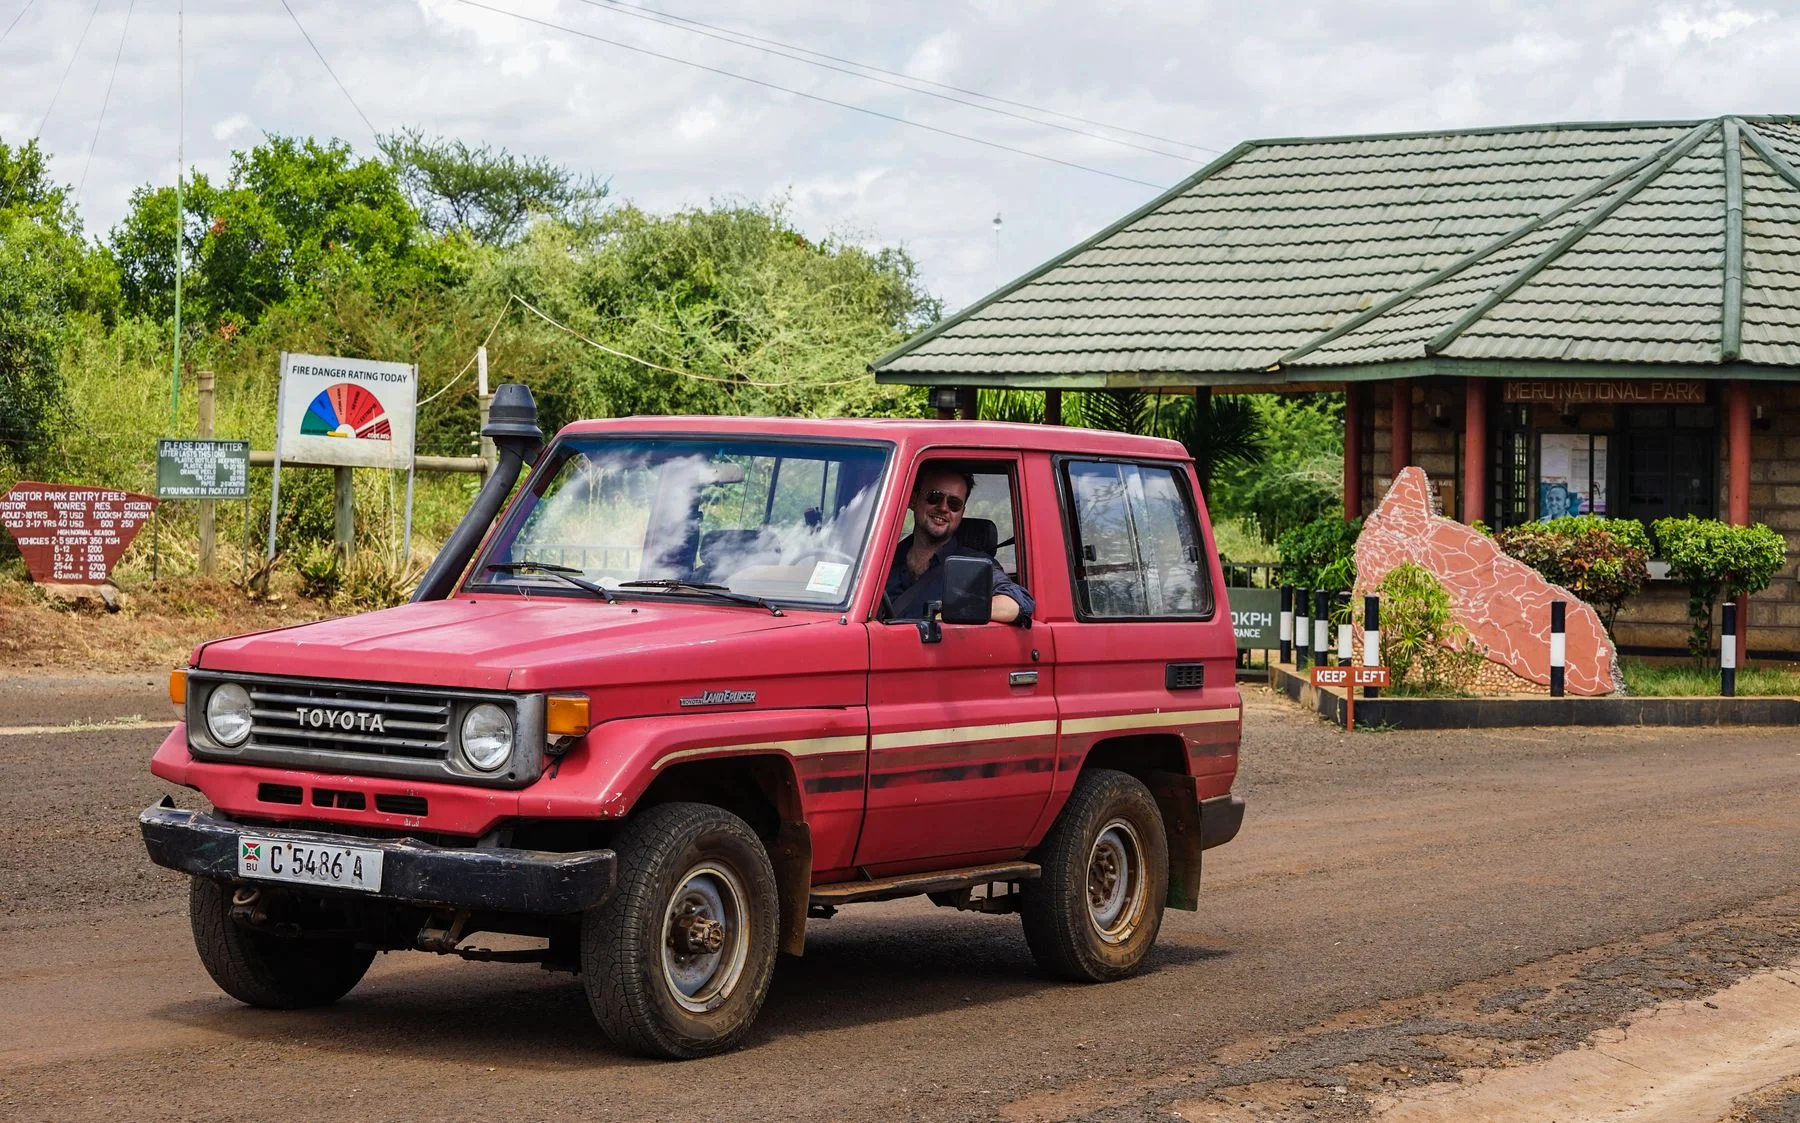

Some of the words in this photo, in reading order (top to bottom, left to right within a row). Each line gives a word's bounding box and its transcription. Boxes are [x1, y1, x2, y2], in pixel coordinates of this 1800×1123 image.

[292, 365, 310, 375] FIRE
[312, 367, 346, 379] DANGER
[348, 370, 378, 381] RATING
[380, 373, 407, 383] TODAY
[1507, 382, 1555, 400] MERU
[1559, 382, 1647, 400] NATIONAL
[1651, 383, 1700, 400] PARK
[164, 442, 193, 451] PLEASE
[218, 443, 243, 452] LITTER
[9, 491, 42, 501] VISITOR
[44, 492, 67, 501] PARK
[69, 492, 100, 501] ENTRY
[102, 492, 126, 501] FEES
[124, 502, 151, 511] CITIZEN
[59, 511, 68, 519] 75
[26, 520, 41, 528] 3-17
[58, 520, 67, 528] 40
[121, 520, 133, 528] 250
[18, 537, 49, 545] VEHICLES
[65, 537, 87, 545] SEATS
[89, 537, 102, 545] 350
[87, 554, 104, 562] 3000
[89, 563, 106, 571] 4700
[54, 571, 63, 579] 45
[1234, 629, 1261, 638] RANCE
[1316, 671, 1347, 682] KEEP
[1355, 671, 1385, 682] LEFT
[296, 707, 385, 733] TOYOTA
[246, 863, 258, 871] BU
[271, 845, 283, 874] C
[292, 848, 343, 879] 5486
[352, 855, 363, 884] A
